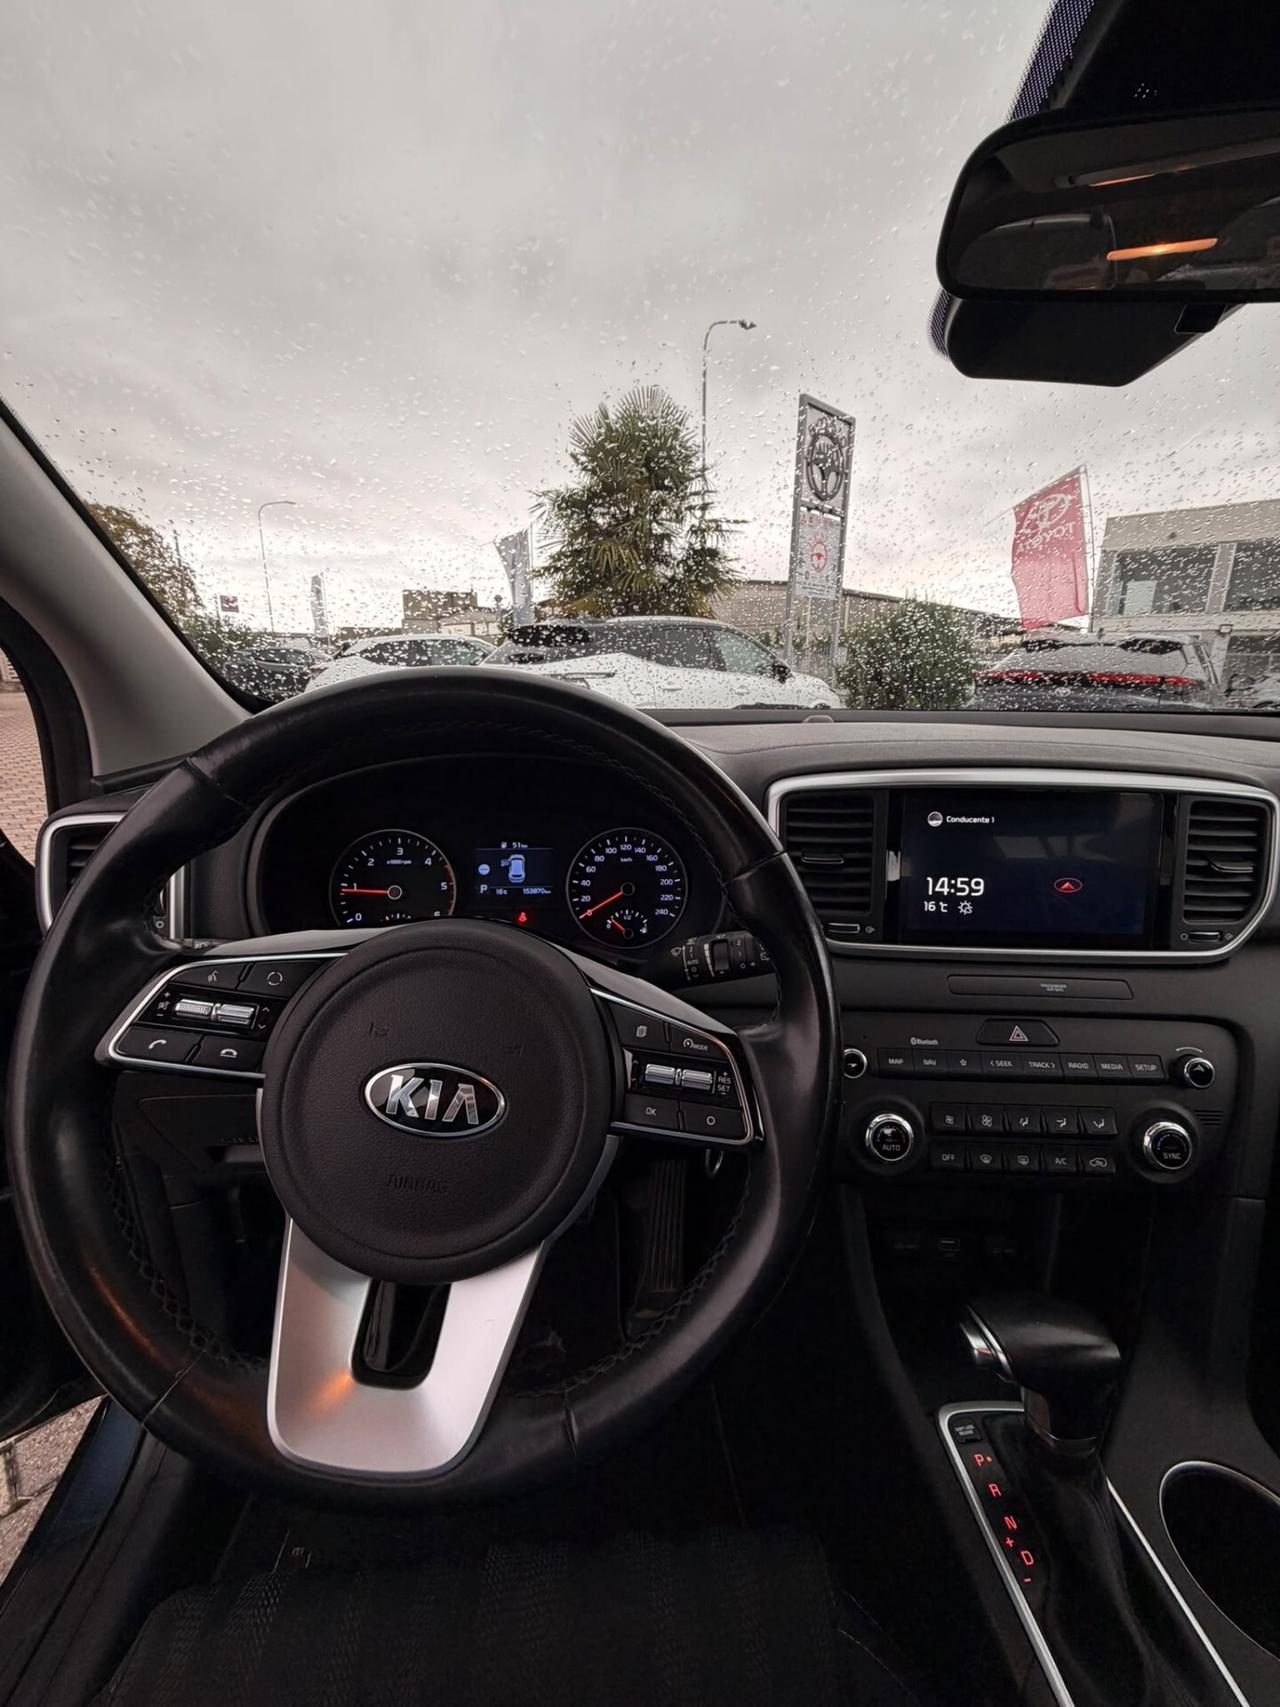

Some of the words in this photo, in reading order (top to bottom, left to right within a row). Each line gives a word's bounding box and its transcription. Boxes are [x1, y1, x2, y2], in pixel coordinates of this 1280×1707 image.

[946, 815, 990, 824] Conducente
[991, 816, 995, 824] 1
[396, 847, 404, 856] 3
[367, 858, 375, 867] 2
[424, 857, 432, 866] 4
[440, 881, 448, 891] 5
[480, 884, 488, 894] P
[926, 877, 985, 897] 14:59
[923, 901, 936, 912] 16
[355, 912, 362, 921] 0
[888, 1057, 904, 1065] MAP
[1028, 1060, 1049, 1069] TRACK
[1068, 1062, 1089, 1070] RADIO
[1101, 1063, 1123, 1071] MEDIA
[718, 1076, 732, 1084] RES
[717, 1085, 730, 1093] SET
[385, 1074, 479, 1125] KIA
[645, 1107, 657, 1116] OK
[882, 1144, 901, 1152] AUTO
[941, 1153, 955, 1162] OFF
[1055, 1157, 1067, 1166] A/C
[974, 1454, 985, 1466] P
[988, 1483, 1002, 1497] R
[1004, 1515, 1018, 1530] N
[1020, 1550, 1034, 1566] D
